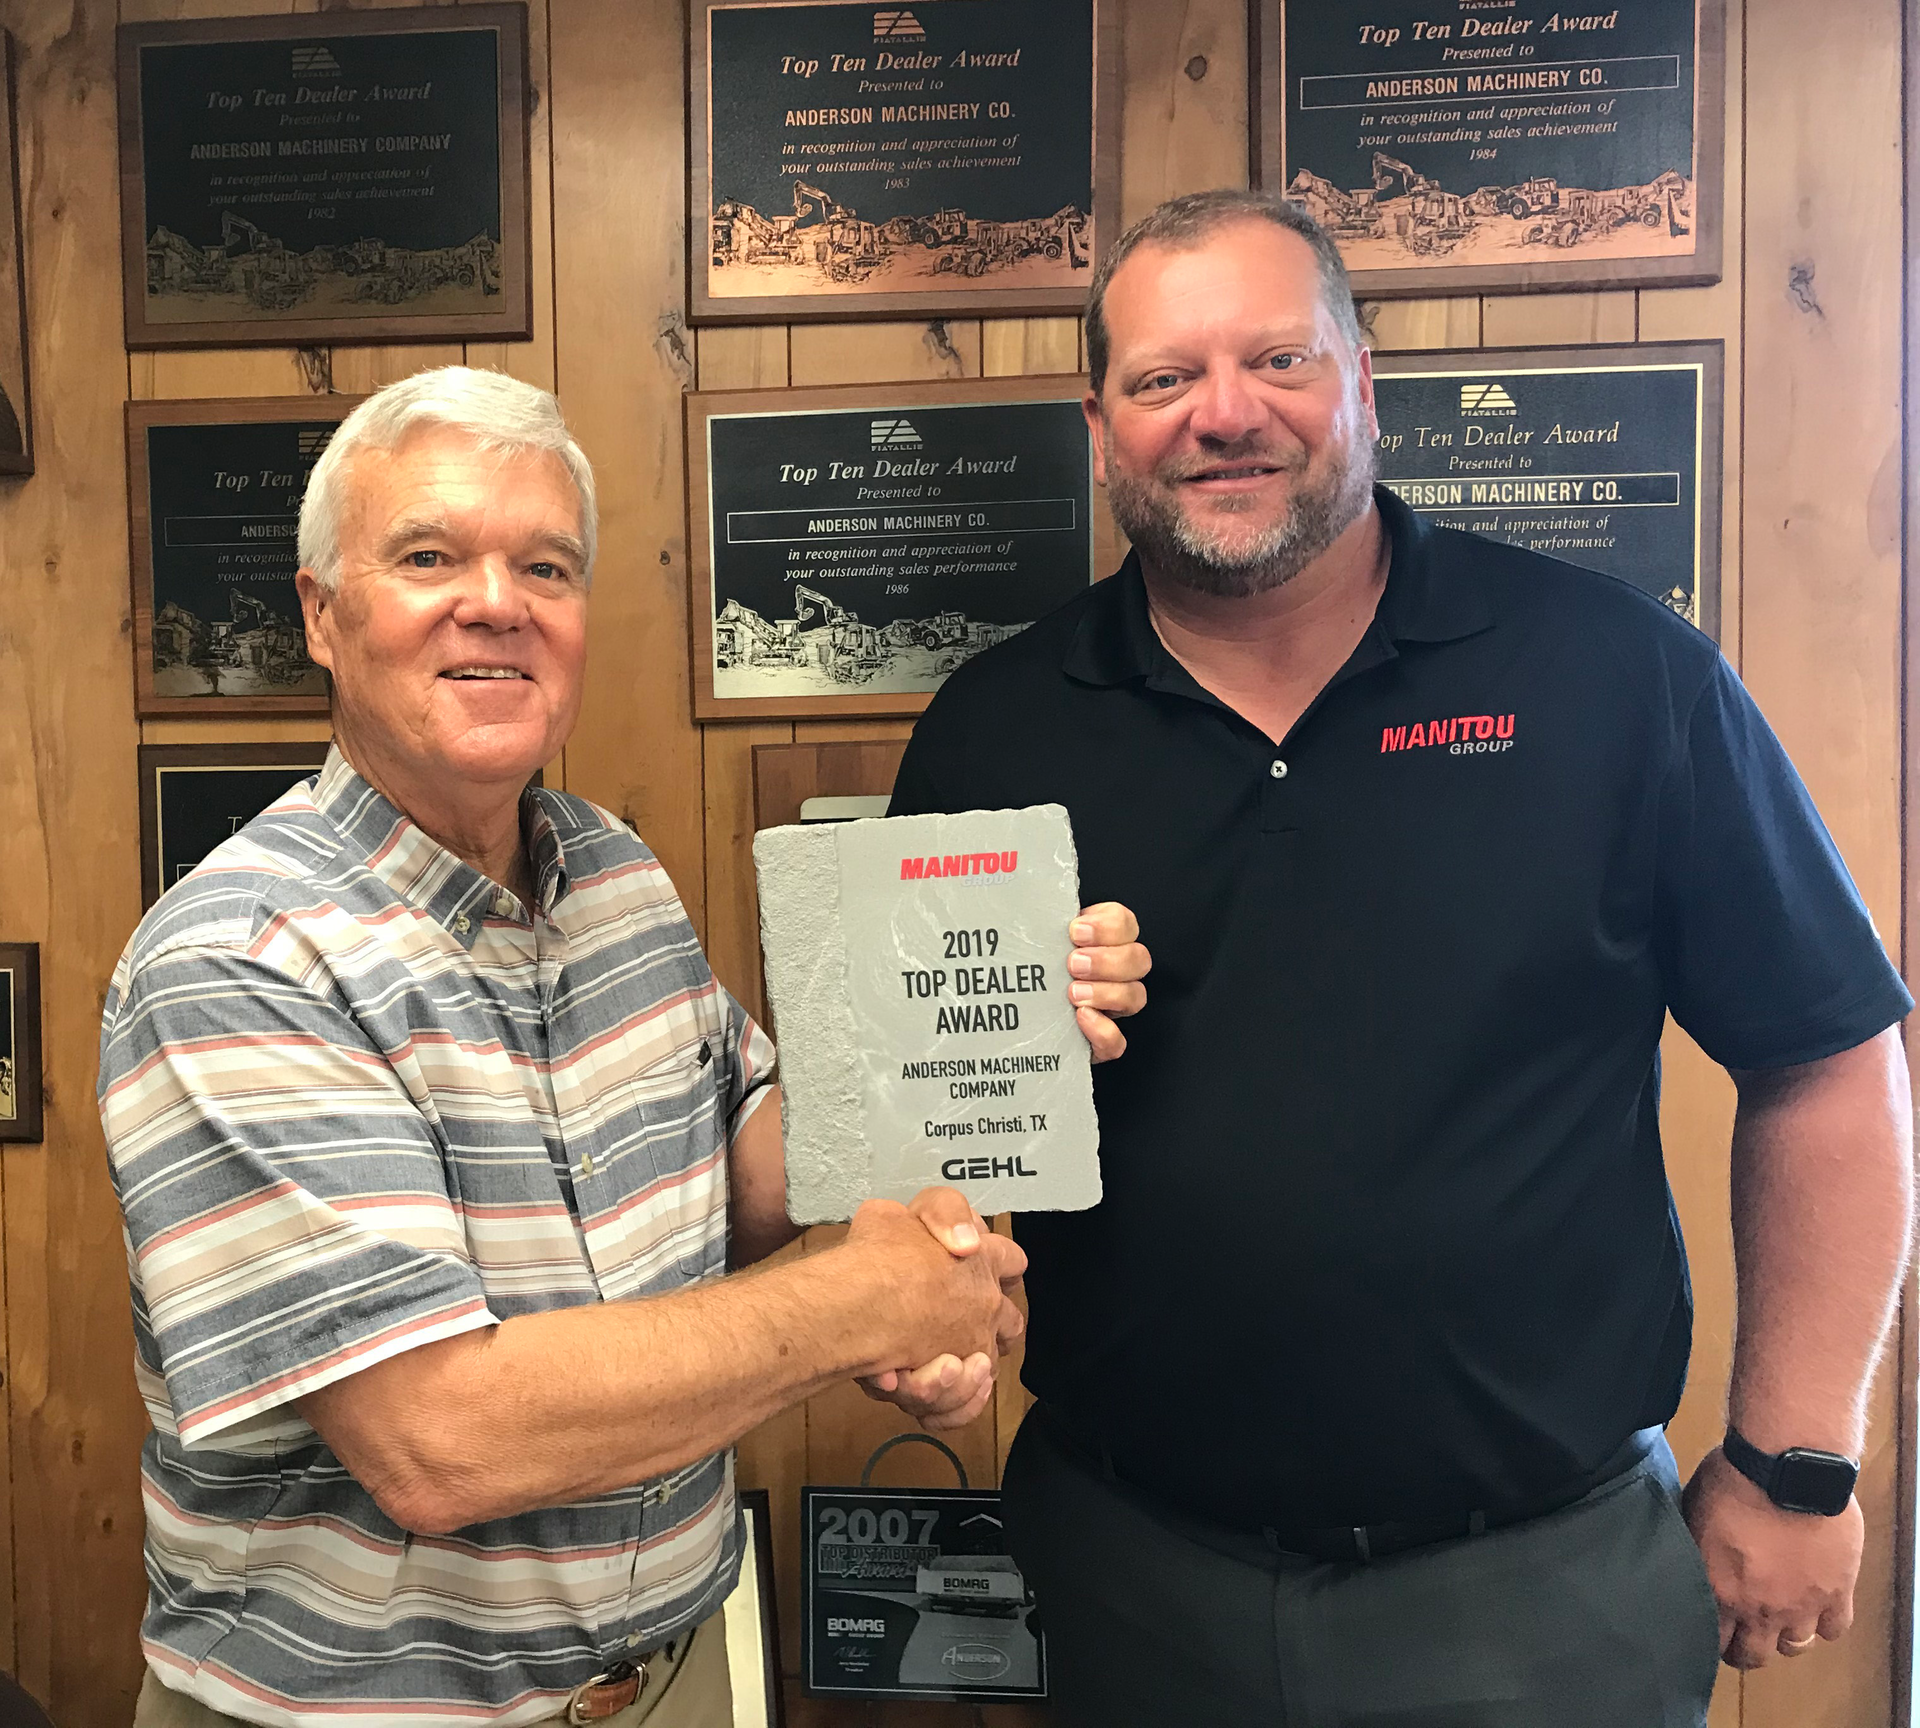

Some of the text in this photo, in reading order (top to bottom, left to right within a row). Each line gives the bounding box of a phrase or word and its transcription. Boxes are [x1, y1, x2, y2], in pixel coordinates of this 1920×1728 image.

[1359, 10, 1619, 47] Top Ten Dealer Award
[781, 48, 1021, 78] Top Ten Dealer Award
[1442, 43, 1534, 61] Presented to
[858, 78, 943, 94] Presented to
[1366, 68, 1608, 98] ANDERSON MACHINERY CO.
[206, 82, 431, 112] Top Ten Dealer Award
[278, 111, 360, 126] Presented to
[785, 101, 1016, 127] ANDERSON MACHINERY CO.
[1360, 99, 1617, 127] in recognition and appreciation of
[782, 133, 1020, 155] in recognition and appreciation of
[1357, 120, 1618, 149] your outstanding sales achievement
[190, 133, 452, 160] ANDERSON MACHINERY COMPANY
[1469, 148, 1498, 161] 1984
[210, 165, 432, 187] in recognition and appreciation of
[780, 154, 1021, 176] your outstanding sales achievement
[884, 178, 910, 190] 1983
[208, 185, 435, 207] your outstanding sales achievement
[307, 207, 337, 219] 1982
[1379, 421, 1620, 453] op Ten Dealer Award
[780, 455, 1018, 486] Top Ten Dealer Award
[1449, 454, 1532, 471] Presented to
[214, 471, 249, 493] Top
[260, 470, 293, 488] Ten
[857, 485, 941, 501] Presented to
[1388, 480, 1623, 506] ERSON MACHINERY CO.
[241, 525, 296, 538] ANDERSO
[807, 513, 990, 534] ANDERSON MACHINERY CO.
[1472, 515, 1498, 532] and
[1504, 514, 1590, 533] appreciation
[1596, 514, 1611, 532] of
[788, 540, 1014, 562] in recognition and appreciation of
[1529, 534, 1616, 552] performance
[217, 550, 297, 565] in recognitio
[216, 570, 296, 584] your outstan
[784, 559, 1018, 581] your outstanding sales performance
[885, 583, 910, 595] 1986
[1380, 714, 1515, 753] MANITOU
[1450, 740, 1514, 755] GROUP
[900, 851, 1018, 881] MANITOU
[961, 874, 1015, 887] GROUP
[942, 928, 999, 959] 2019
[902, 964, 1047, 999] TOP DEALER
[936, 1004, 1019, 1035] AWARD
[901, 1054, 1061, 1080] ANDERSON MACHINERY
[949, 1079, 1016, 1100] COMPANY
[925, 1114, 1047, 1139] Corpus Christi, TX
[941, 1156, 1037, 1181] GEHL
[818, 1507, 940, 1545] 2007
[821, 1546, 937, 1561] TOP DISTRIBUTOR
[944, 1577, 989, 1590] BOMAG
[827, 1617, 885, 1633] BOMAG
